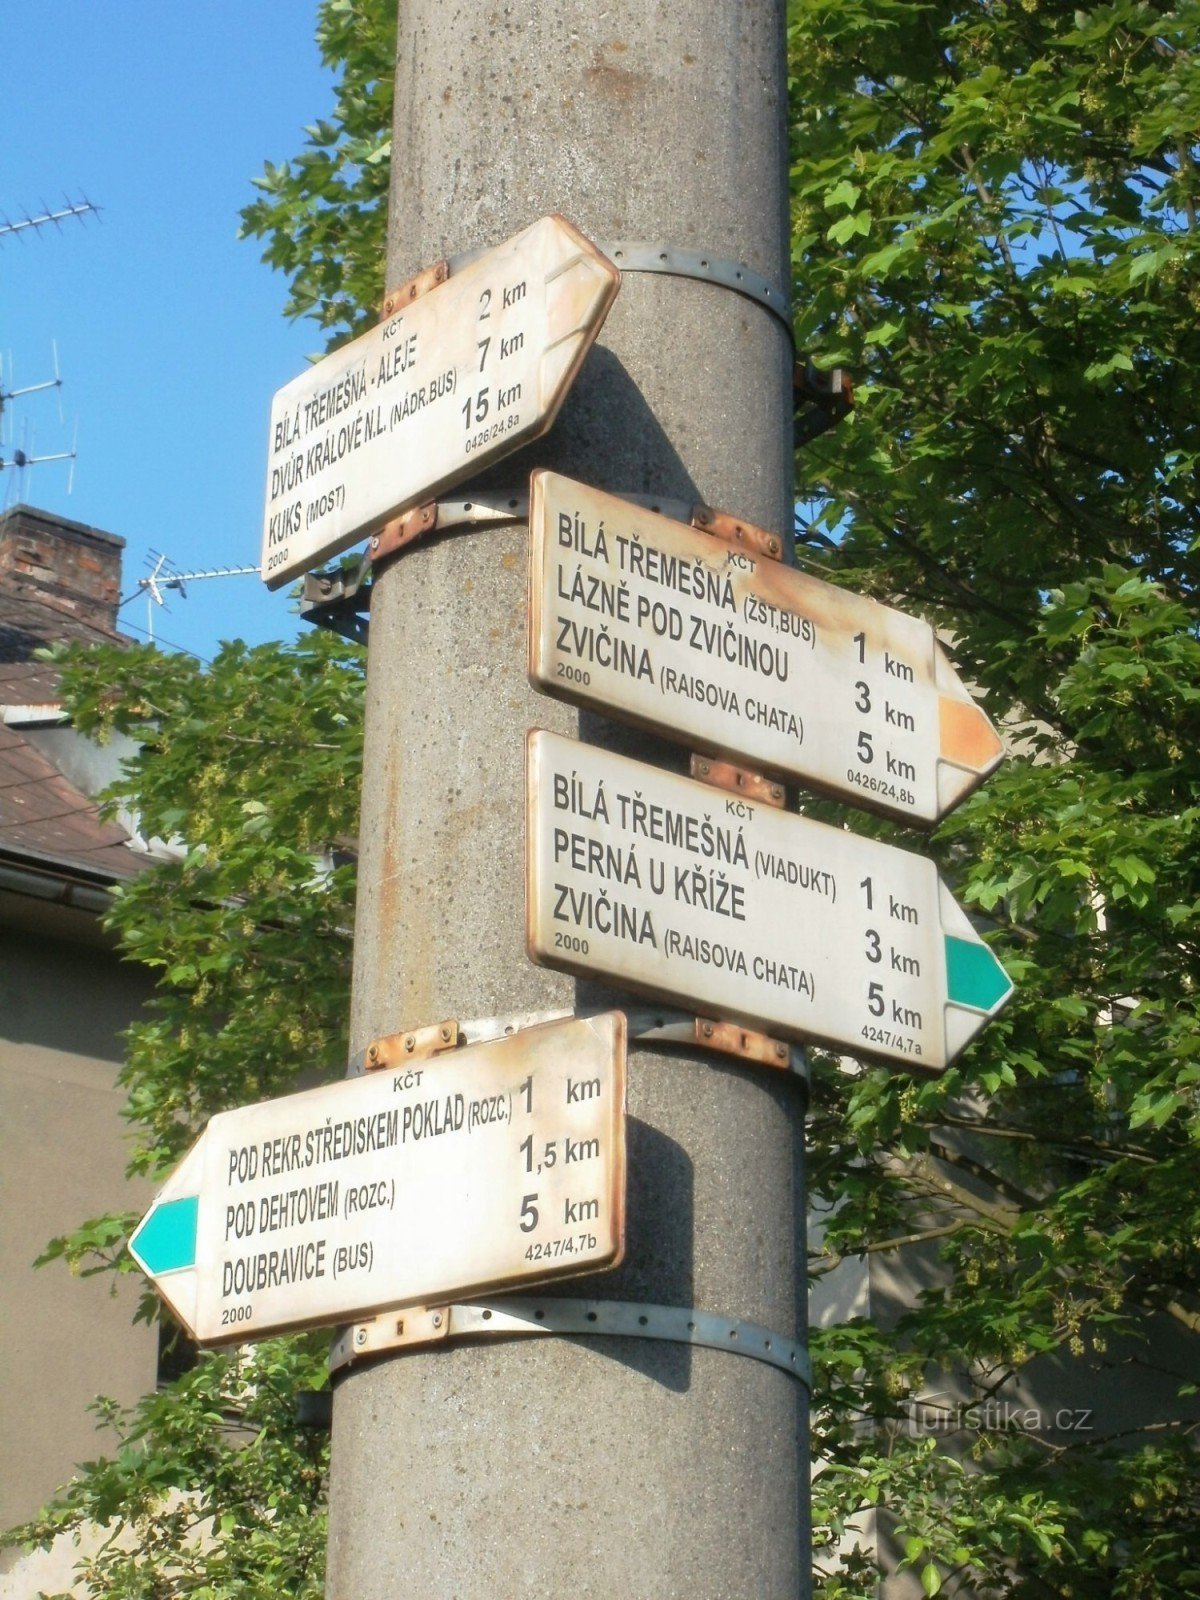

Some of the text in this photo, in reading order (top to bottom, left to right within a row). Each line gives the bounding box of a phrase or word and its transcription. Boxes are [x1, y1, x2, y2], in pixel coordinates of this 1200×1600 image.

[274, 409, 300, 454] BÍLÁ
[305, 359, 367, 433] TŘEMEŠNÁ
[377, 333, 418, 389] ALEJE
[479, 288, 491, 322] 2
[503, 279, 526, 310] km
[382, 317, 403, 342] KČT
[269, 383, 521, 548] KUKS (MOST) 15 km
[271, 453, 303, 501] DVŮR
[306, 410, 362, 479] KRÁLOVÉ
[479, 337, 491, 373] 7
[500, 330, 524, 361] km
[268, 550, 288, 571] 2000
[558, 511, 608, 563] BÍLÁ
[616, 532, 736, 613] TŘEMEŠNÁ
[853, 632, 866, 665] 1
[884, 653, 914, 684] km
[727, 551, 756, 573] KČT
[556, 617, 916, 782] ZVIČINA (RAISOVA CHATA) 5 km
[557, 564, 915, 732] LÁZNĚ POD ZVIČINOU 3 km
[558, 663, 591, 687] 2000
[553, 773, 918, 925] BÍLÁ TŘEMEŠNÁ (VIADUKT) 1 km
[725, 800, 754, 821] KČT
[554, 829, 920, 977] PERNÁ U KŘÍŽE 3 km
[555, 932, 589, 956] 2000
[553, 884, 922, 1031] ZVIČINA (RAISOVA CHATA) 5 km
[228, 1145, 257, 1186] POD
[402, 1094, 464, 1144] POKLAD
[520, 1076, 533, 1115] 1
[567, 1077, 601, 1103] km
[393, 1071, 424, 1093] KČT
[226, 1201, 255, 1241] POD
[260, 1182, 338, 1235] DEHTOVEM
[565, 1136, 599, 1163] km
[222, 1194, 599, 1298] DOUBRAVICE (BUS) 5 km
[222, 1305, 252, 1326] 2000
